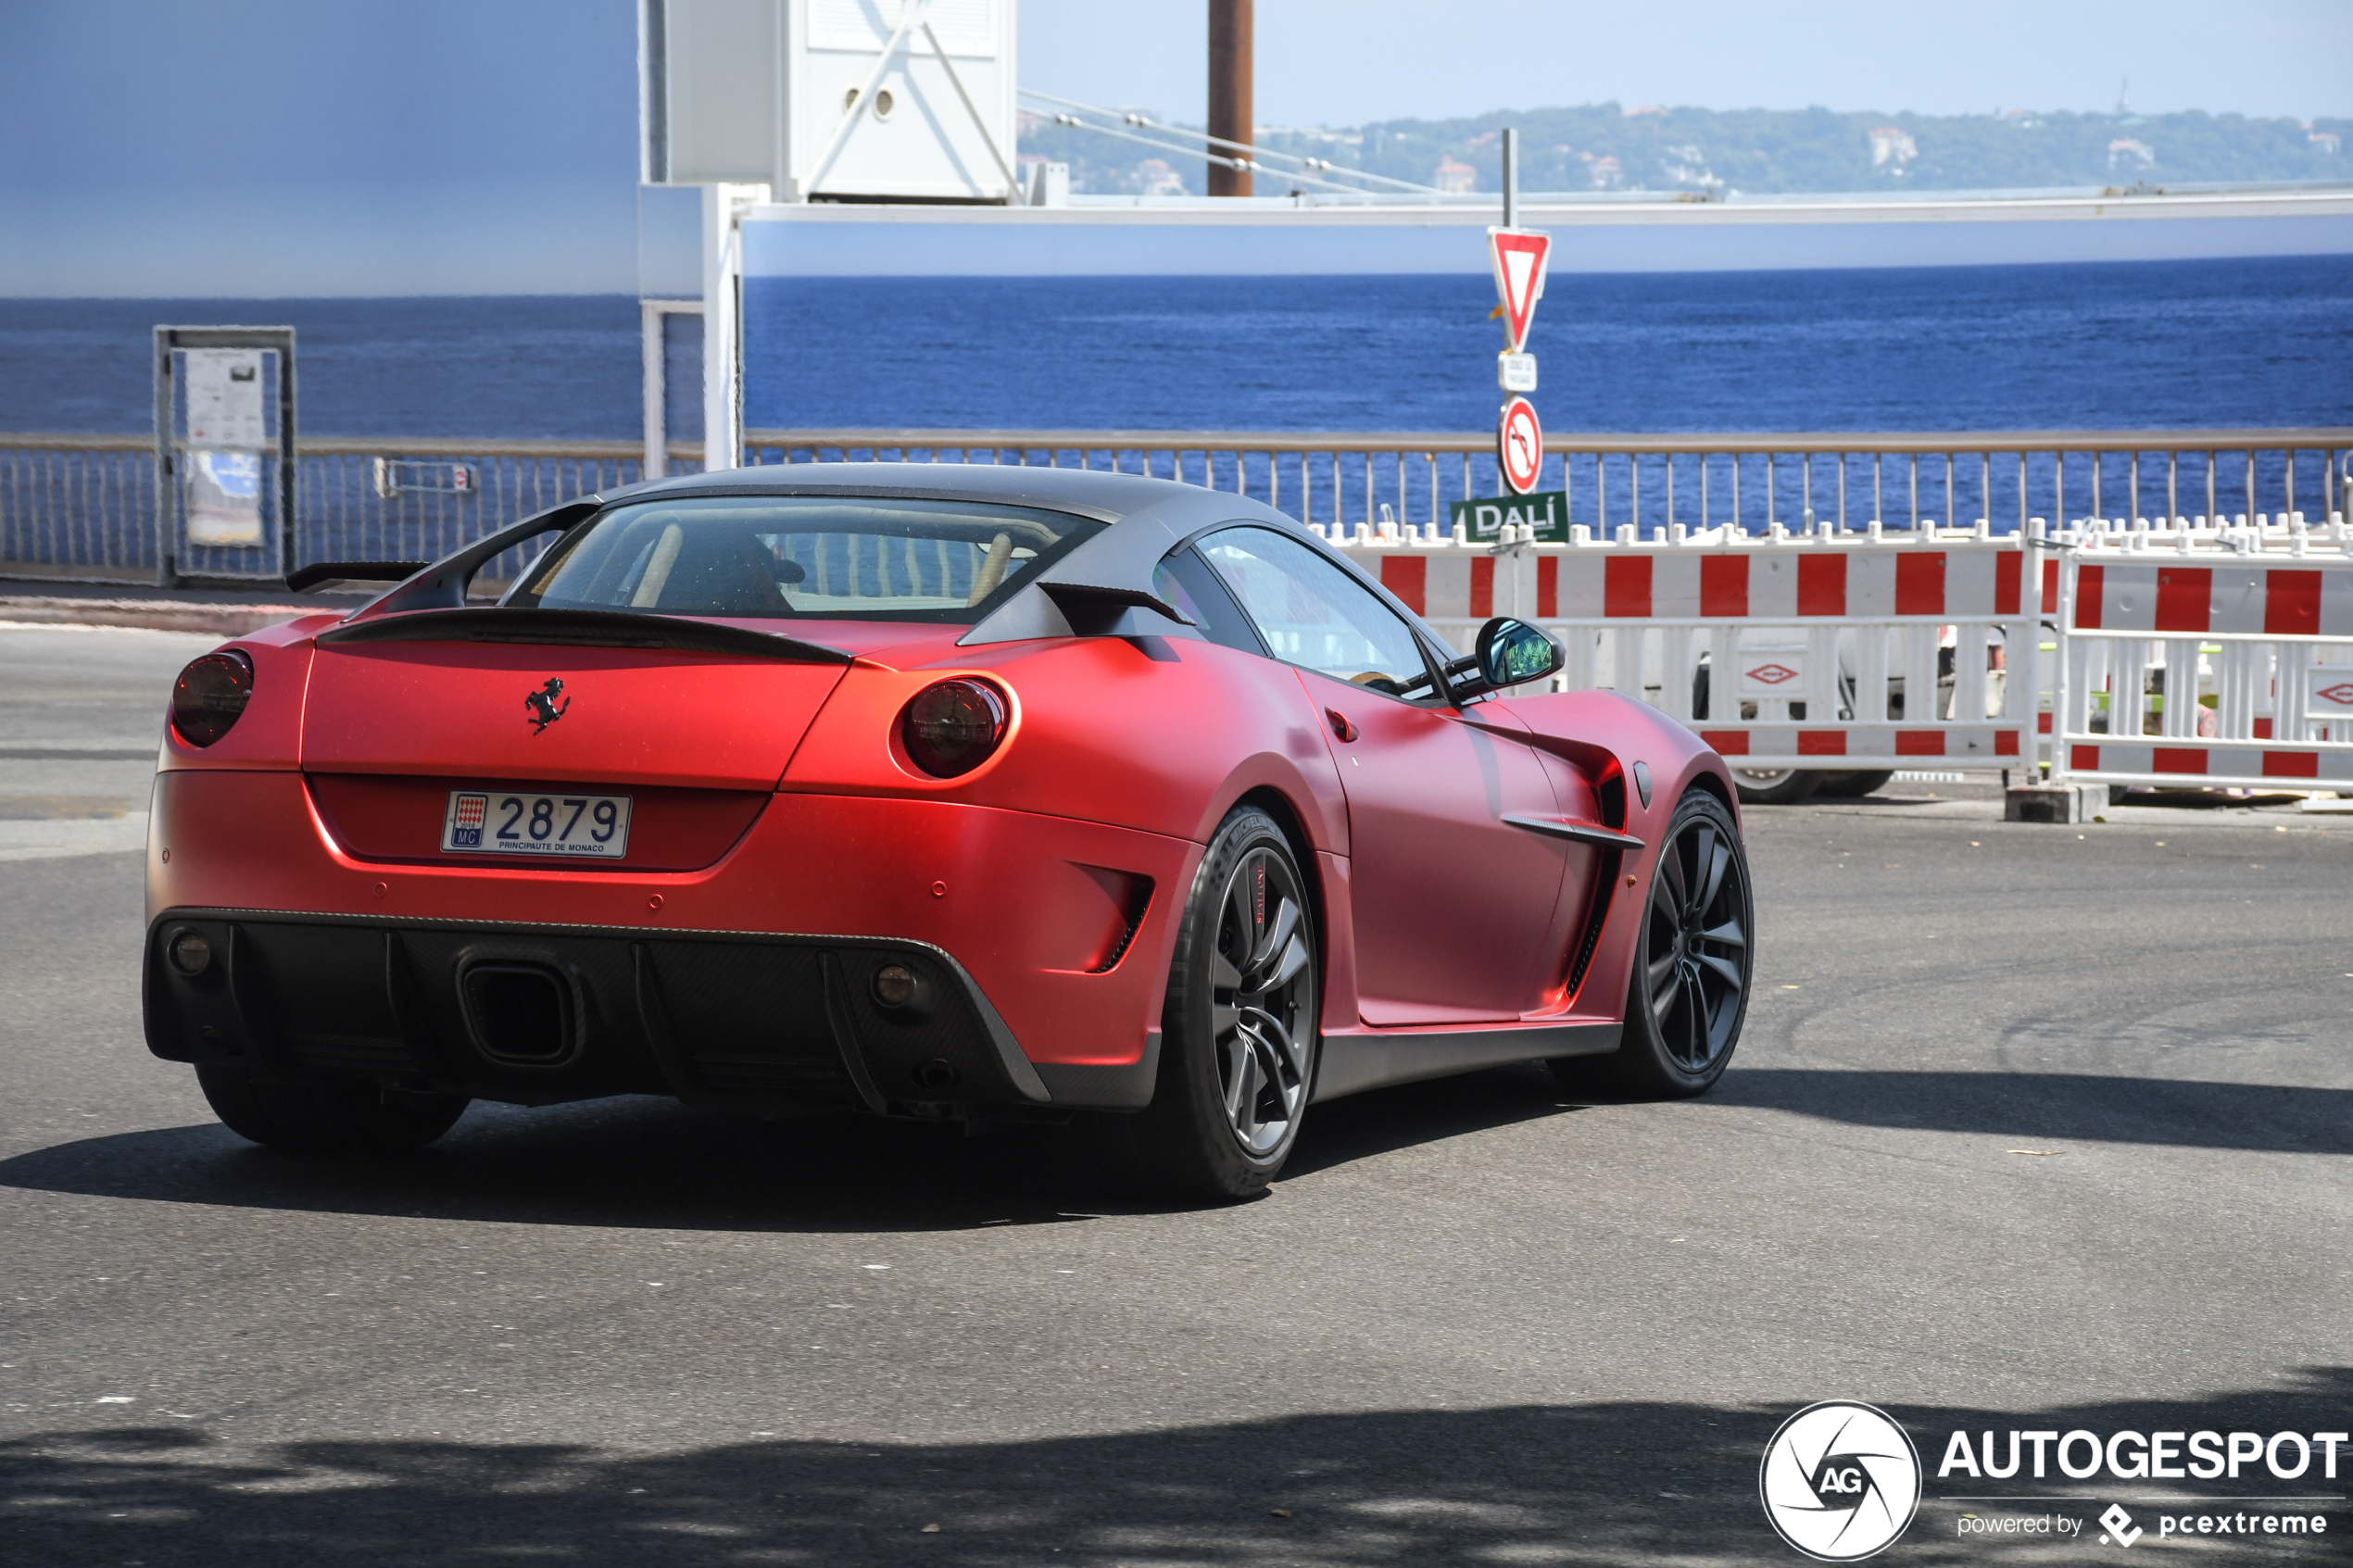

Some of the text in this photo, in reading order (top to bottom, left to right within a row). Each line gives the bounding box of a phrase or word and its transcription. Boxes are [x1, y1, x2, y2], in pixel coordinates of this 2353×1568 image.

[1475, 495, 1555, 533] DALÍ
[497, 797, 617, 842] 2879
[458, 831, 476, 844] MC
[498, 841, 604, 852] PRINCIPAUTE DE MONACO
